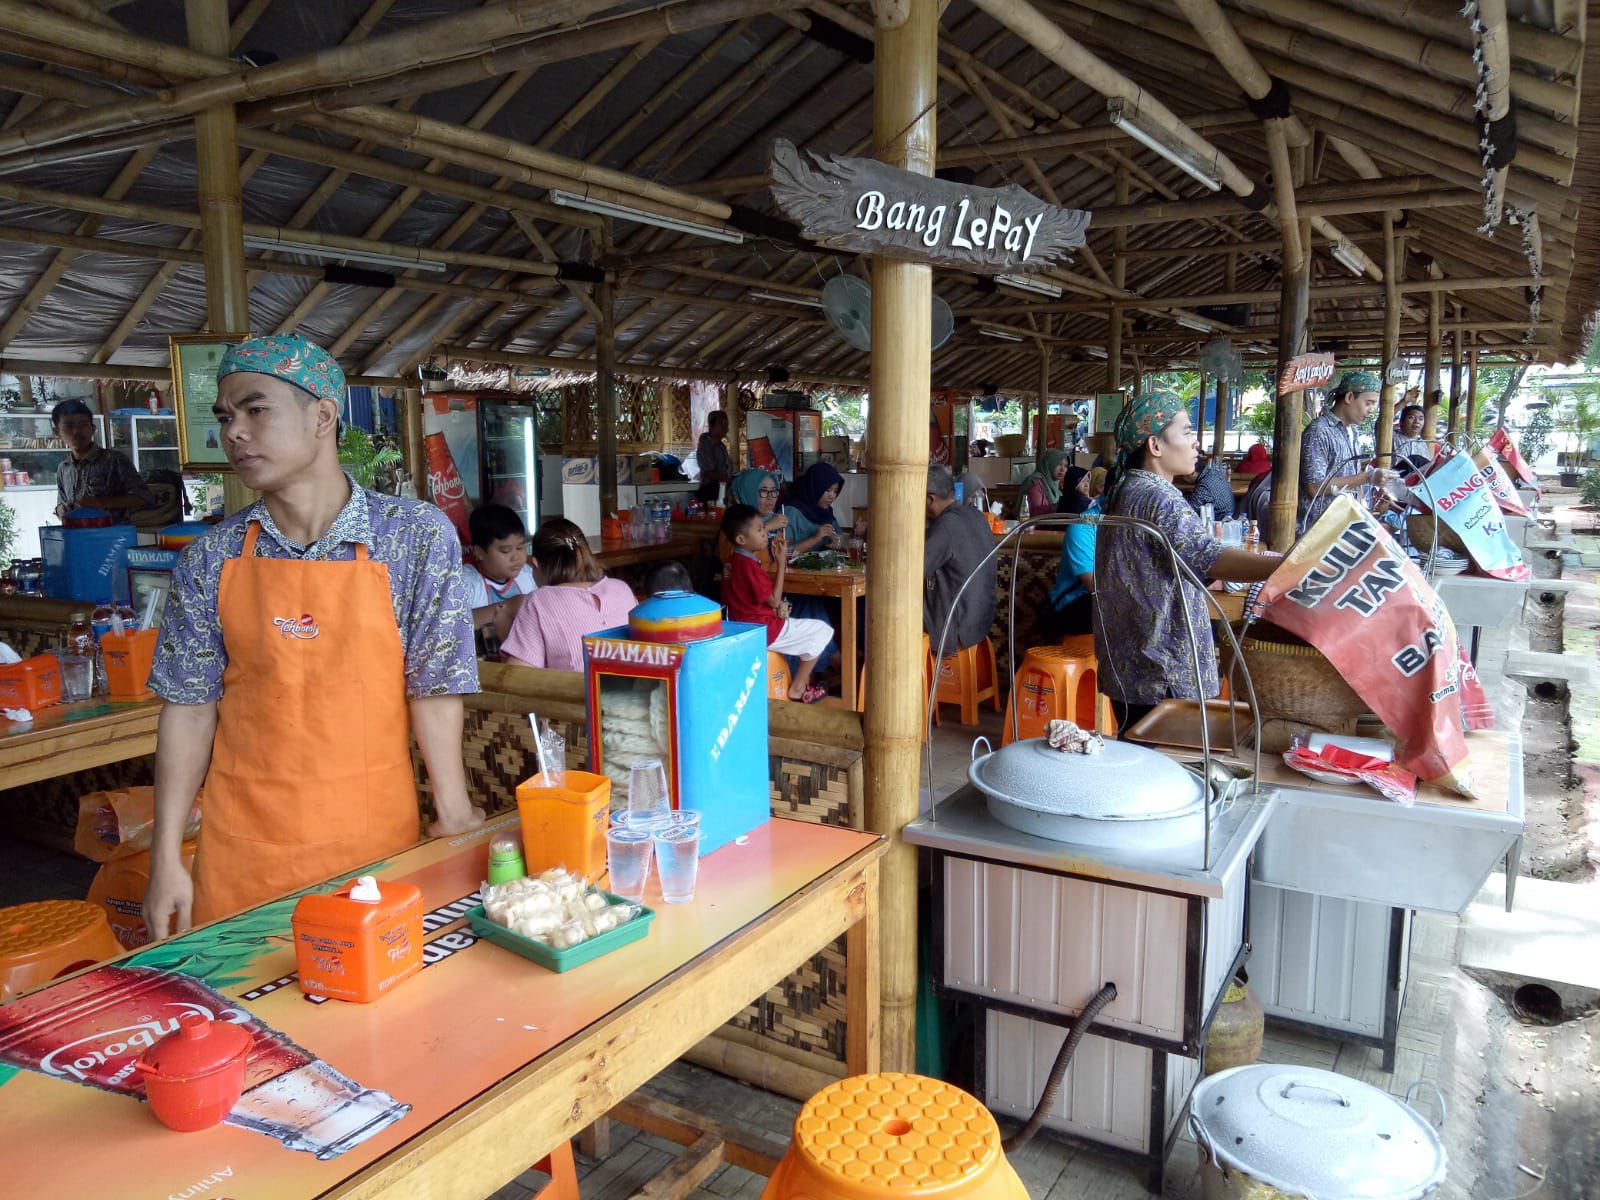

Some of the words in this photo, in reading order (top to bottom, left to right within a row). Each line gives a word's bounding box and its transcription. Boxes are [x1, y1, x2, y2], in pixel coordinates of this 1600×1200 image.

[856, 190, 946, 247] Bang
[1437, 472, 1485, 512] BANG
[1286, 519, 1380, 608] KULIN
[1334, 557, 1407, 618] TAN
[592, 640, 670, 666] IDAMAN
[1392, 630, 1442, 678] BA
[710, 656, 762, 760] IDAMAN
